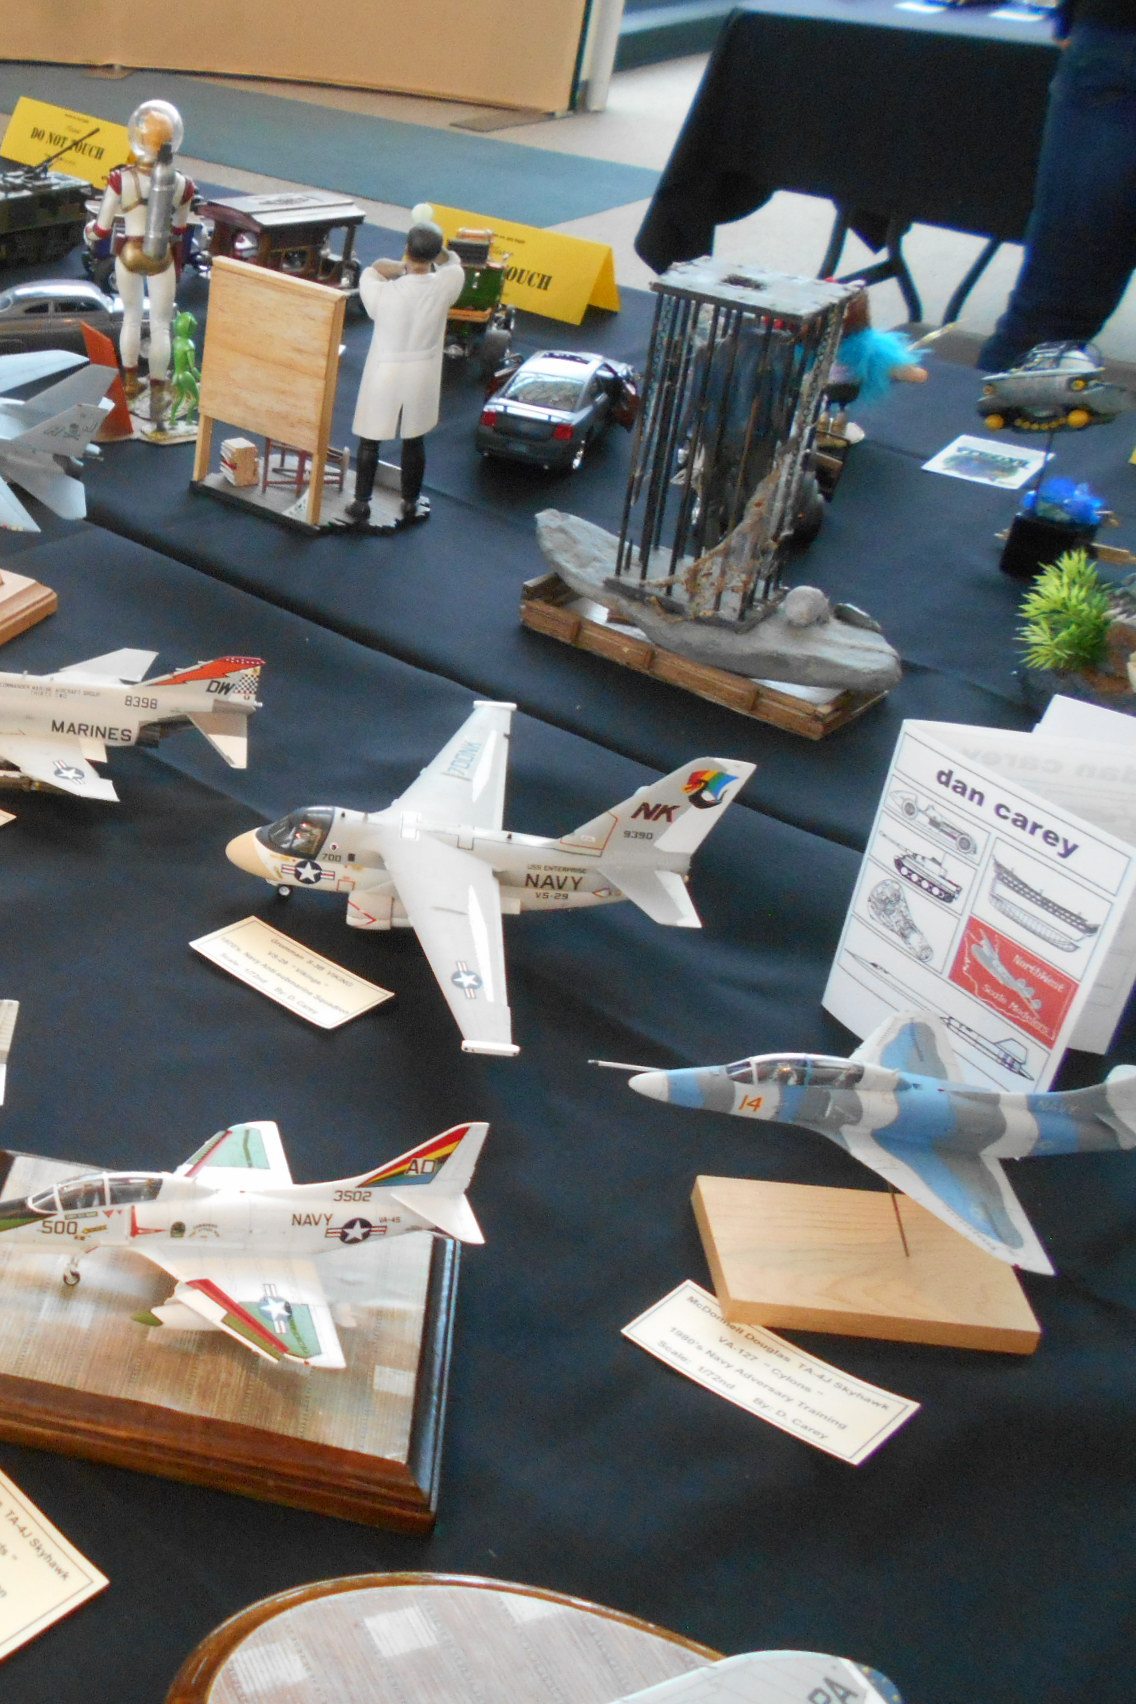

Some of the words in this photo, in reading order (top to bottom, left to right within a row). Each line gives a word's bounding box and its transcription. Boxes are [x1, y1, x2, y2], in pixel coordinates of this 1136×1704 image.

[31, 127, 45, 141] DO
[47, 132, 68, 149] NOT
[505, 265, 552, 291] OUCH
[206, 680, 236, 695] DW
[125, 695, 158, 710] 8398
[51, 719, 132, 742] MARINES
[630, 802, 680, 823] NK
[936, 769, 986, 807] dan
[994, 803, 1079, 859] carey
[623, 830, 653, 841] 9390
[321, 853, 341, 863] 700
[525, 873, 583, 891] NAVY
[535, 892, 569, 900] VS-29
[738, 1094, 764, 1112] 14
[405, 1158, 437, 1175] AD
[334, 1190, 372, 1202] 3502
[42, 1220, 78, 1235] 500
[292, 1213, 333, 1226] NAVY
[741, 1331, 795, 1363] Douglas
[831, 1378, 892, 1415] Skyhawk
[702, 1349, 736, 1370] Navy
[733, 1367, 795, 1403] Adversary
[795, 1398, 849, 1431] Training
[789, 1416, 830, 1441] Carey
[2, 1509, 32, 1540] TA-4J
[26, 1535, 71, 1583] Skyhawk
